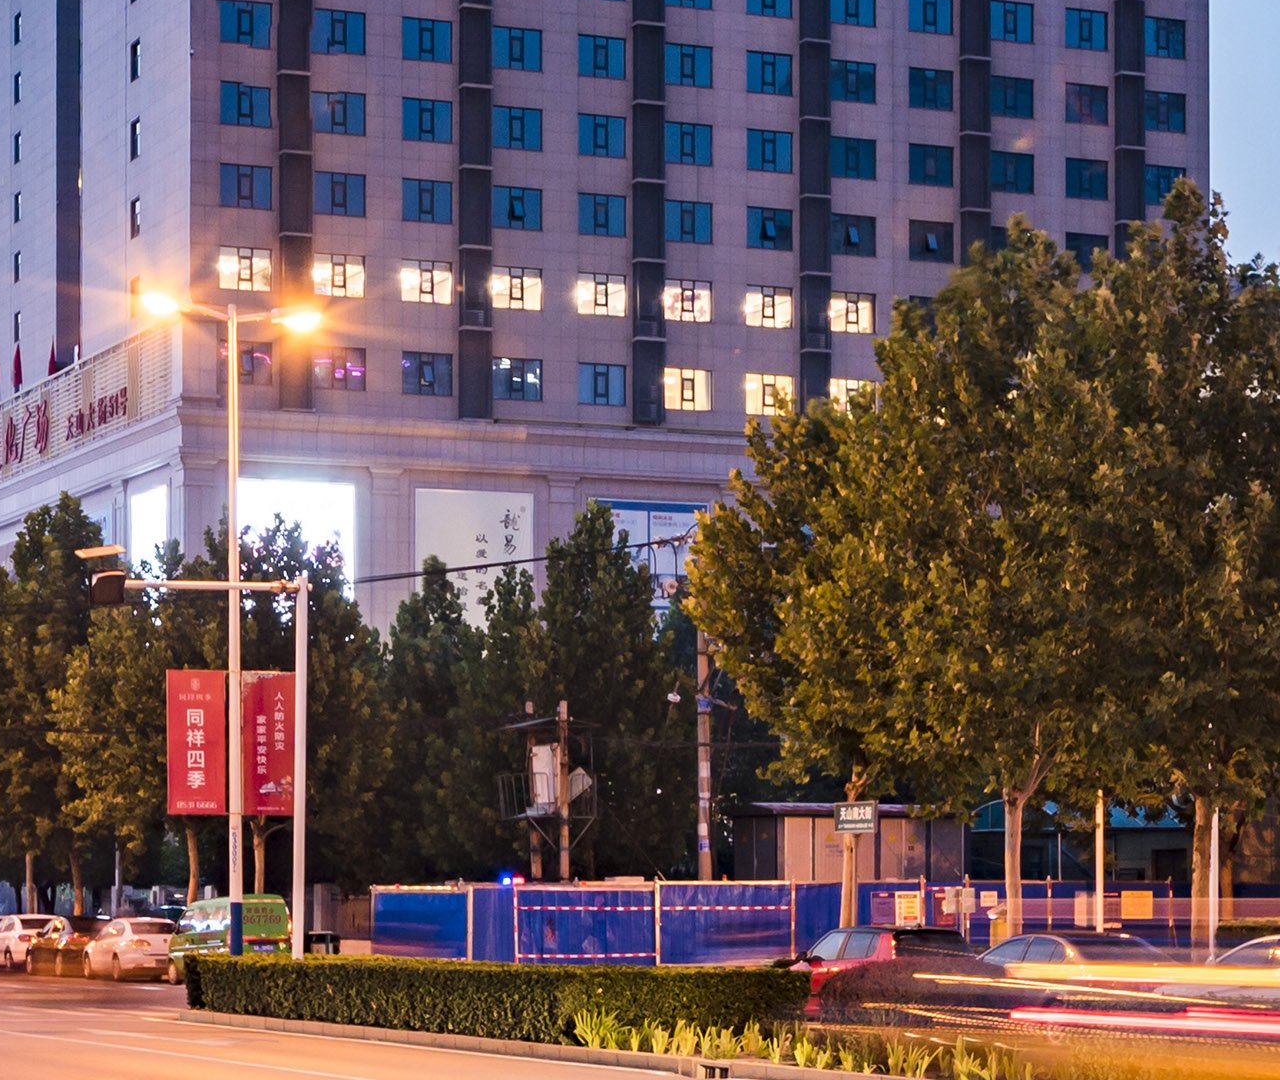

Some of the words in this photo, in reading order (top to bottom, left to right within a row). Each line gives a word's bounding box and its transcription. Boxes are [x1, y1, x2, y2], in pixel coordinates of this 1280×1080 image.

[186, 708, 206, 789] 同祥四季
[256, 715, 268, 775] 家家平安快乐
[274, 691, 286, 751] 人人防火防灾
